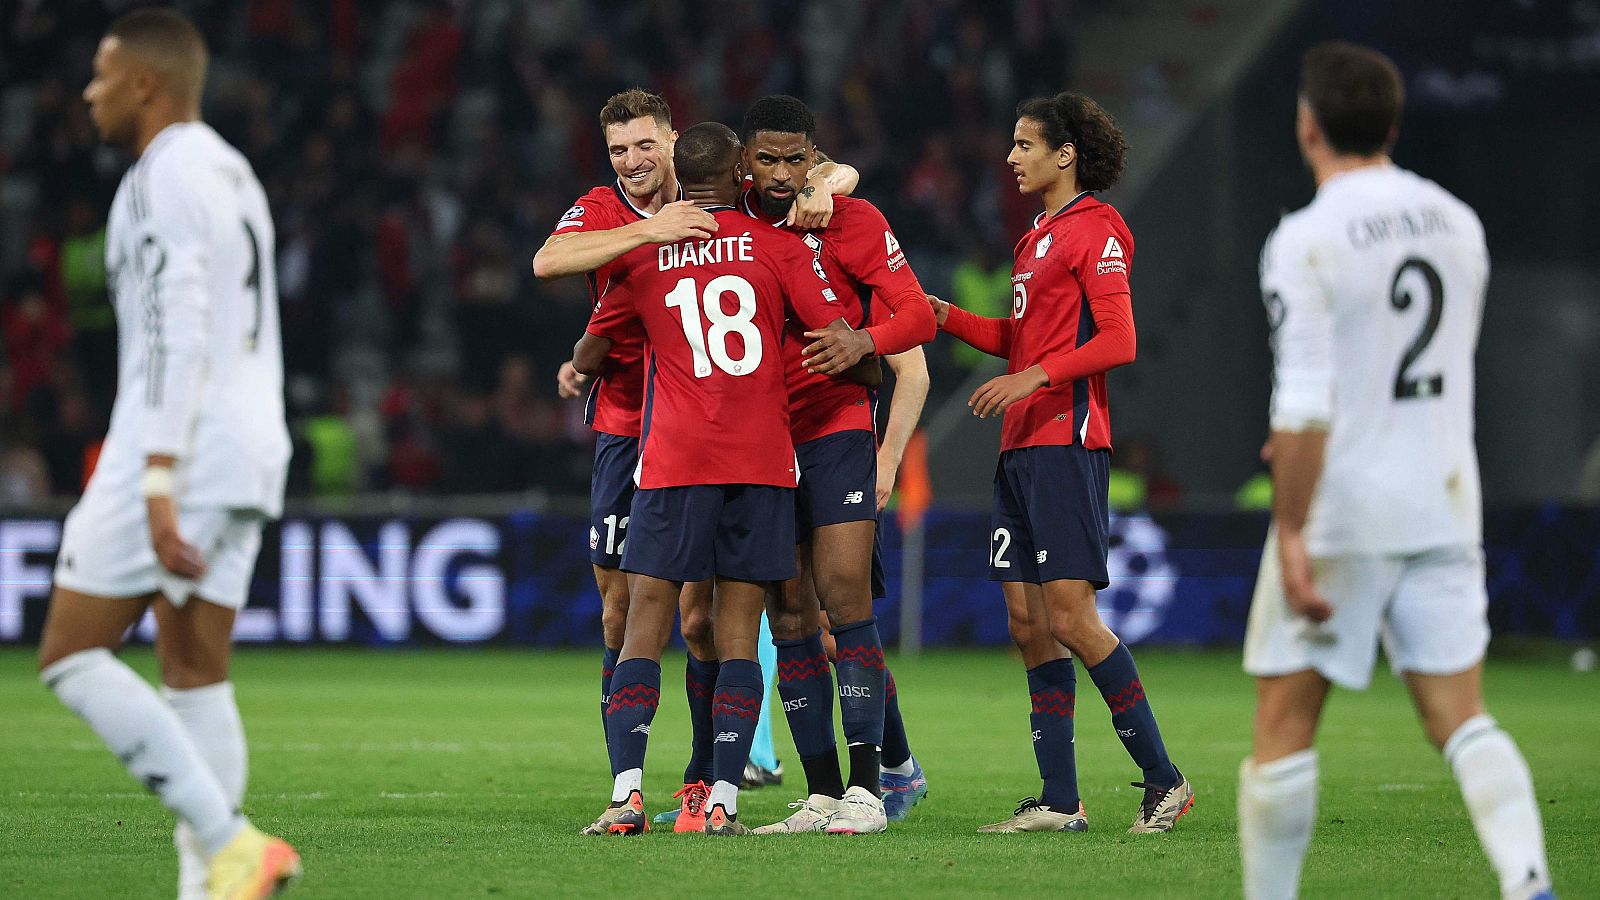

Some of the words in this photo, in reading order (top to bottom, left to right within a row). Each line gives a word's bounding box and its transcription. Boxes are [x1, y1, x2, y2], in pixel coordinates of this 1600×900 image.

[658, 231, 754, 272] DIAKITÉ
[1097, 260, 1127, 270] Alumini
[1097, 267, 1127, 276] Dunker
[664, 275, 763, 379] 18
[1391, 259, 1444, 401] 2
[989, 527, 1011, 568] 2
[0, 518, 507, 643] FING
[838, 684, 871, 698] LOSC
[783, 696, 808, 712] OSC
[1031, 729, 1042, 742] SC
[1116, 728, 1136, 738] OSC
